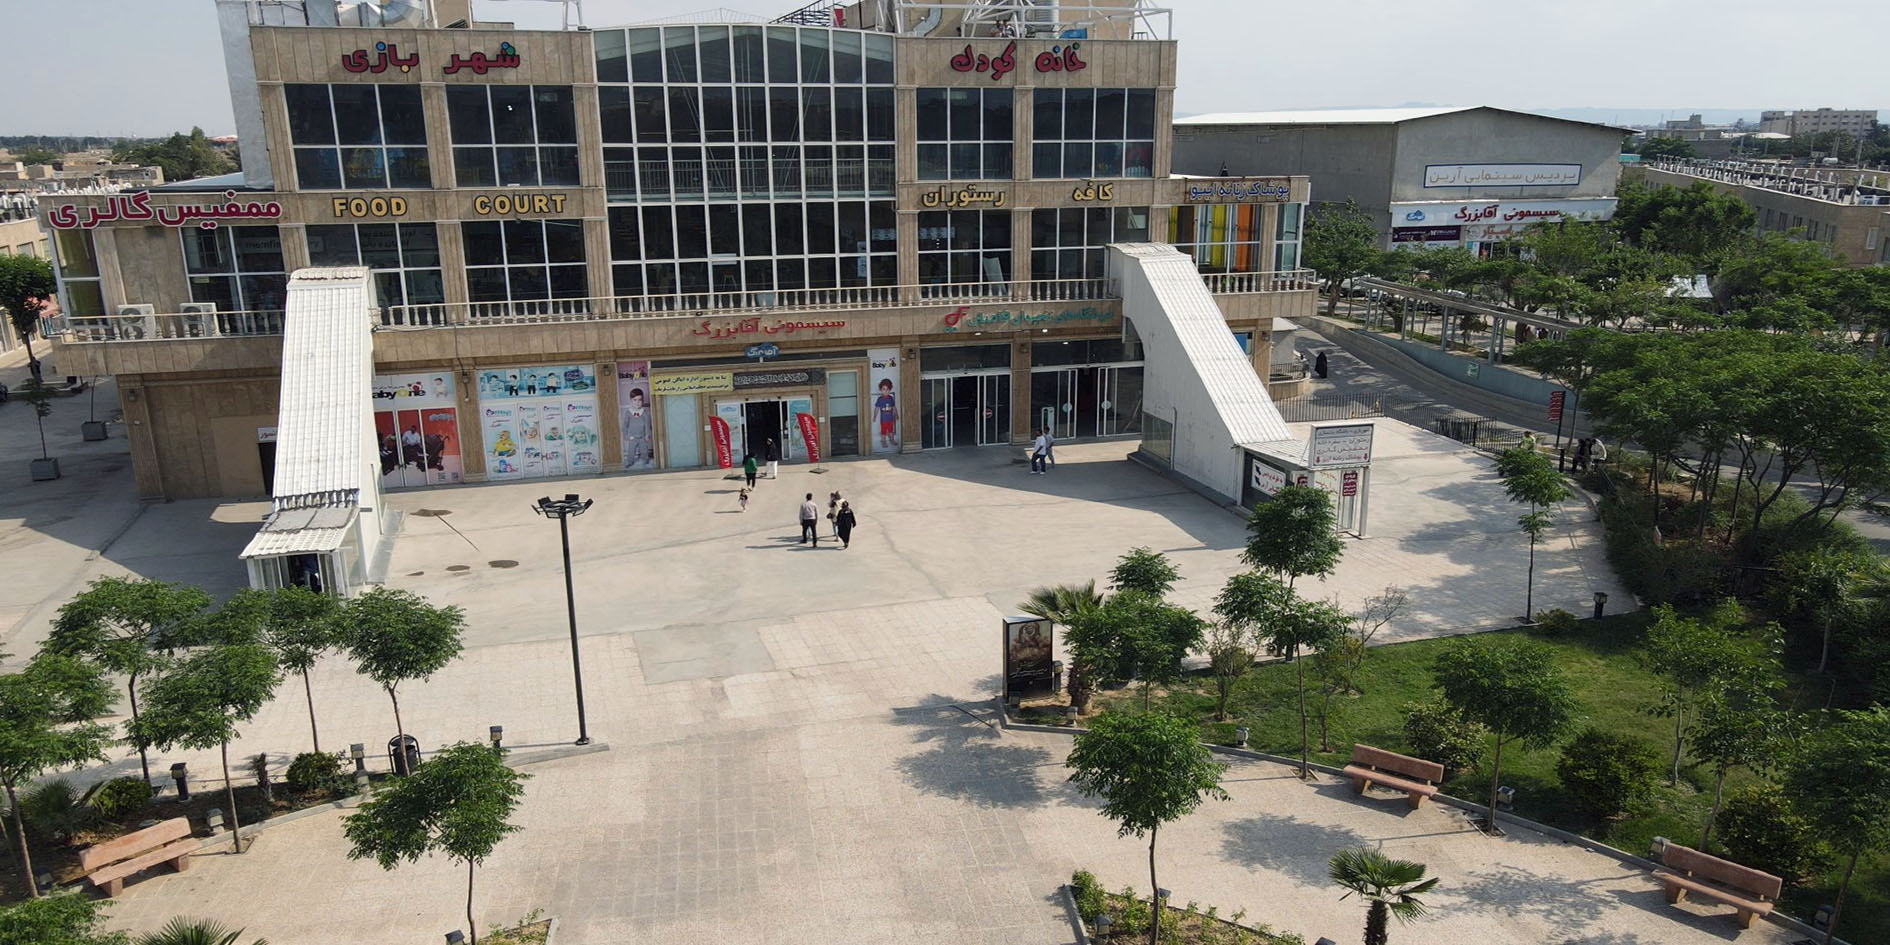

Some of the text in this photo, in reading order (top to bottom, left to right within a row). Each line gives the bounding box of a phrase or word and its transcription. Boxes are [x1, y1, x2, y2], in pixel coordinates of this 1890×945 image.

[342, 41, 520, 75] شهر بازی
[950, 40, 1088, 80] خانه کودک
[1429, 166, 1576, 184] پردیس سینمایی آرین
[922, 182, 1114, 208] رستوران کافه
[1218, 180, 1247, 200] زنانه
[1247, 179, 1291, 201] پوشاک
[48, 189, 283, 230] ممفیس گالری
[333, 194, 568, 218] FOOD COURT
[1454, 204, 1560, 223] سیسمونی آقابزرگ
[692, 317, 846, 340] سیسمونی آقابزرگ
[372, 388, 427, 400] abyOne
